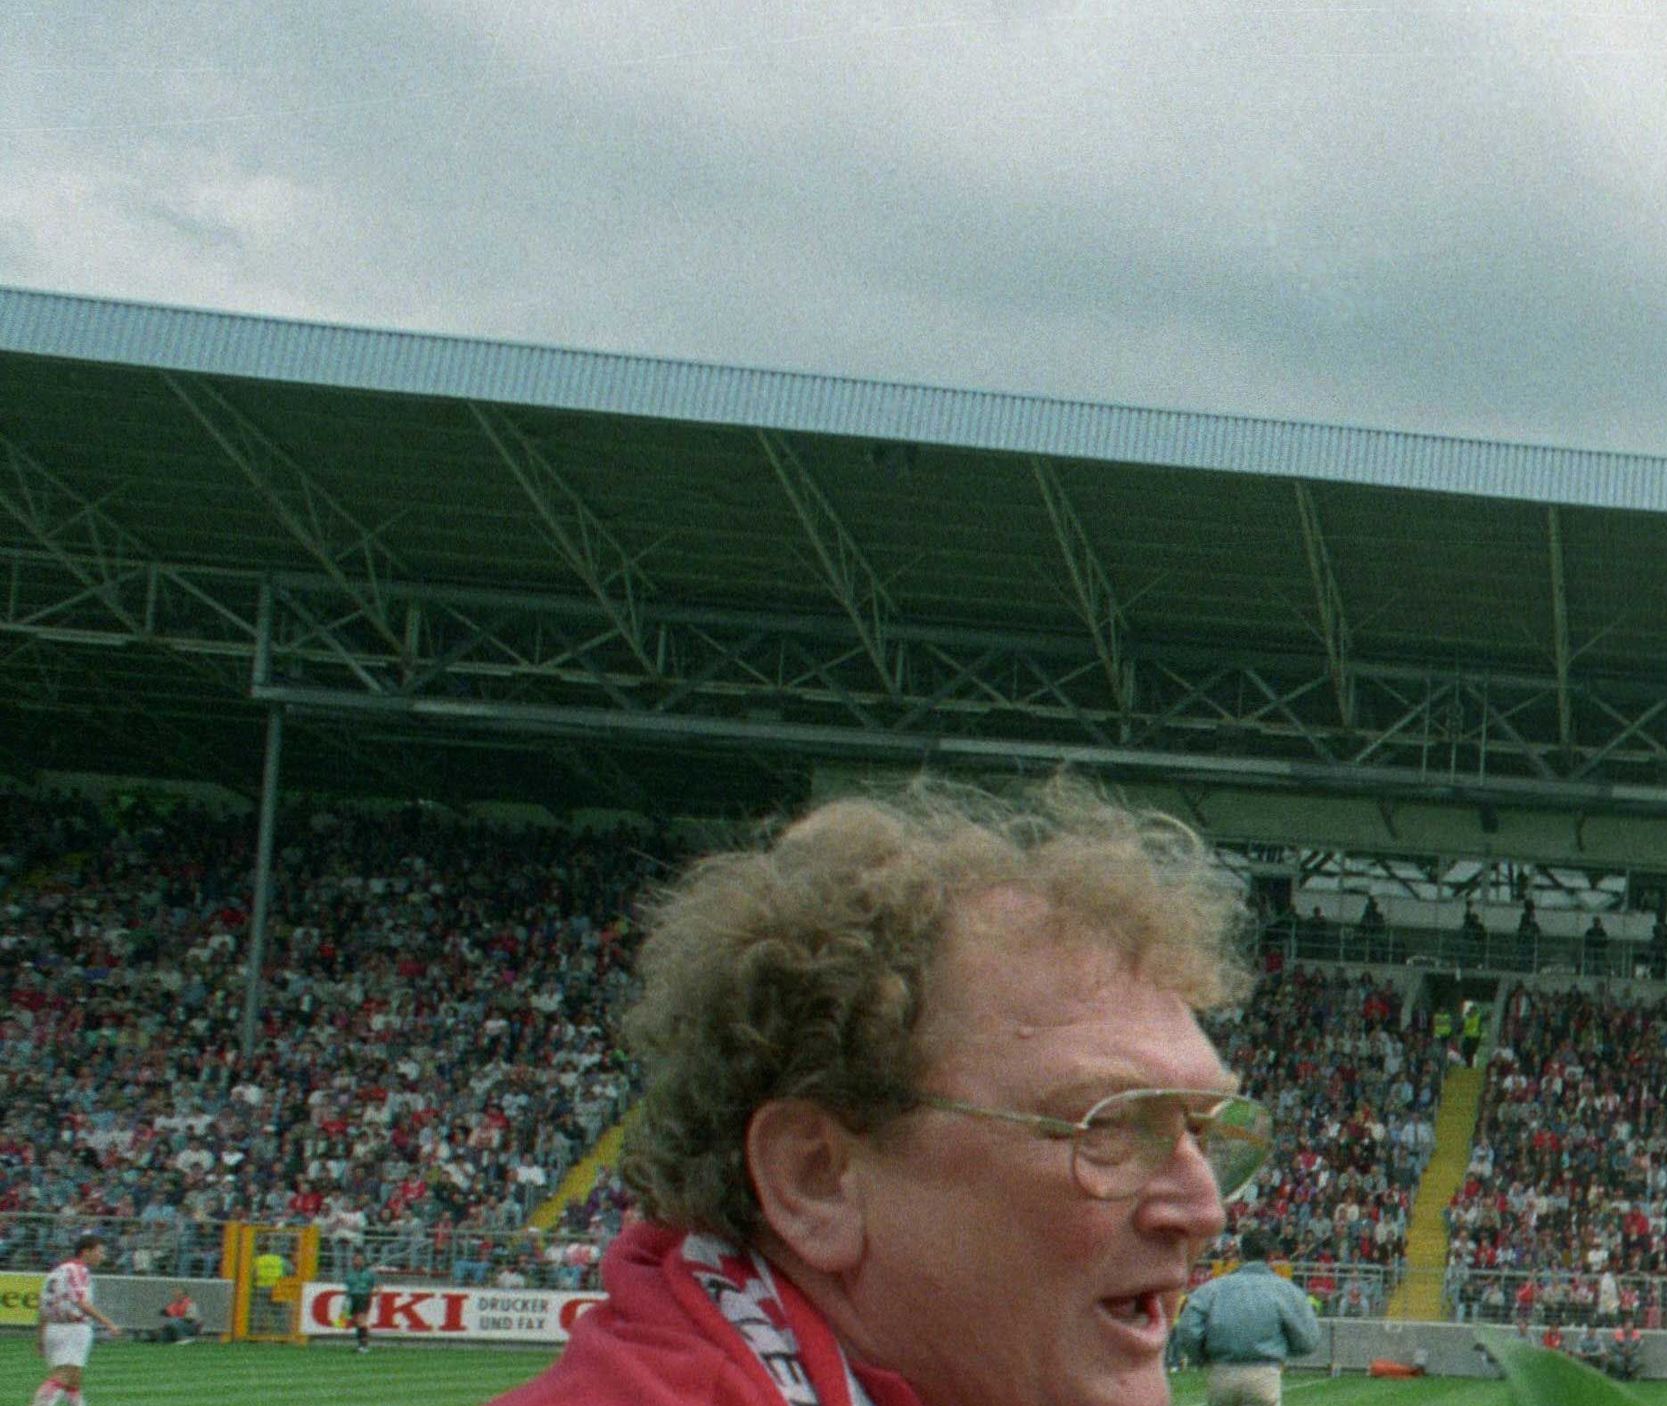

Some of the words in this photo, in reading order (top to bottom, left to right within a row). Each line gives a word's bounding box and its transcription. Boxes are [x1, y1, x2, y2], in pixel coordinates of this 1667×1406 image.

[311, 1289, 470, 1332] OKI
[478, 1298, 548, 1313] DRUCKER
[479, 1315, 512, 1331] UND
[518, 1316, 546, 1331] FAX
